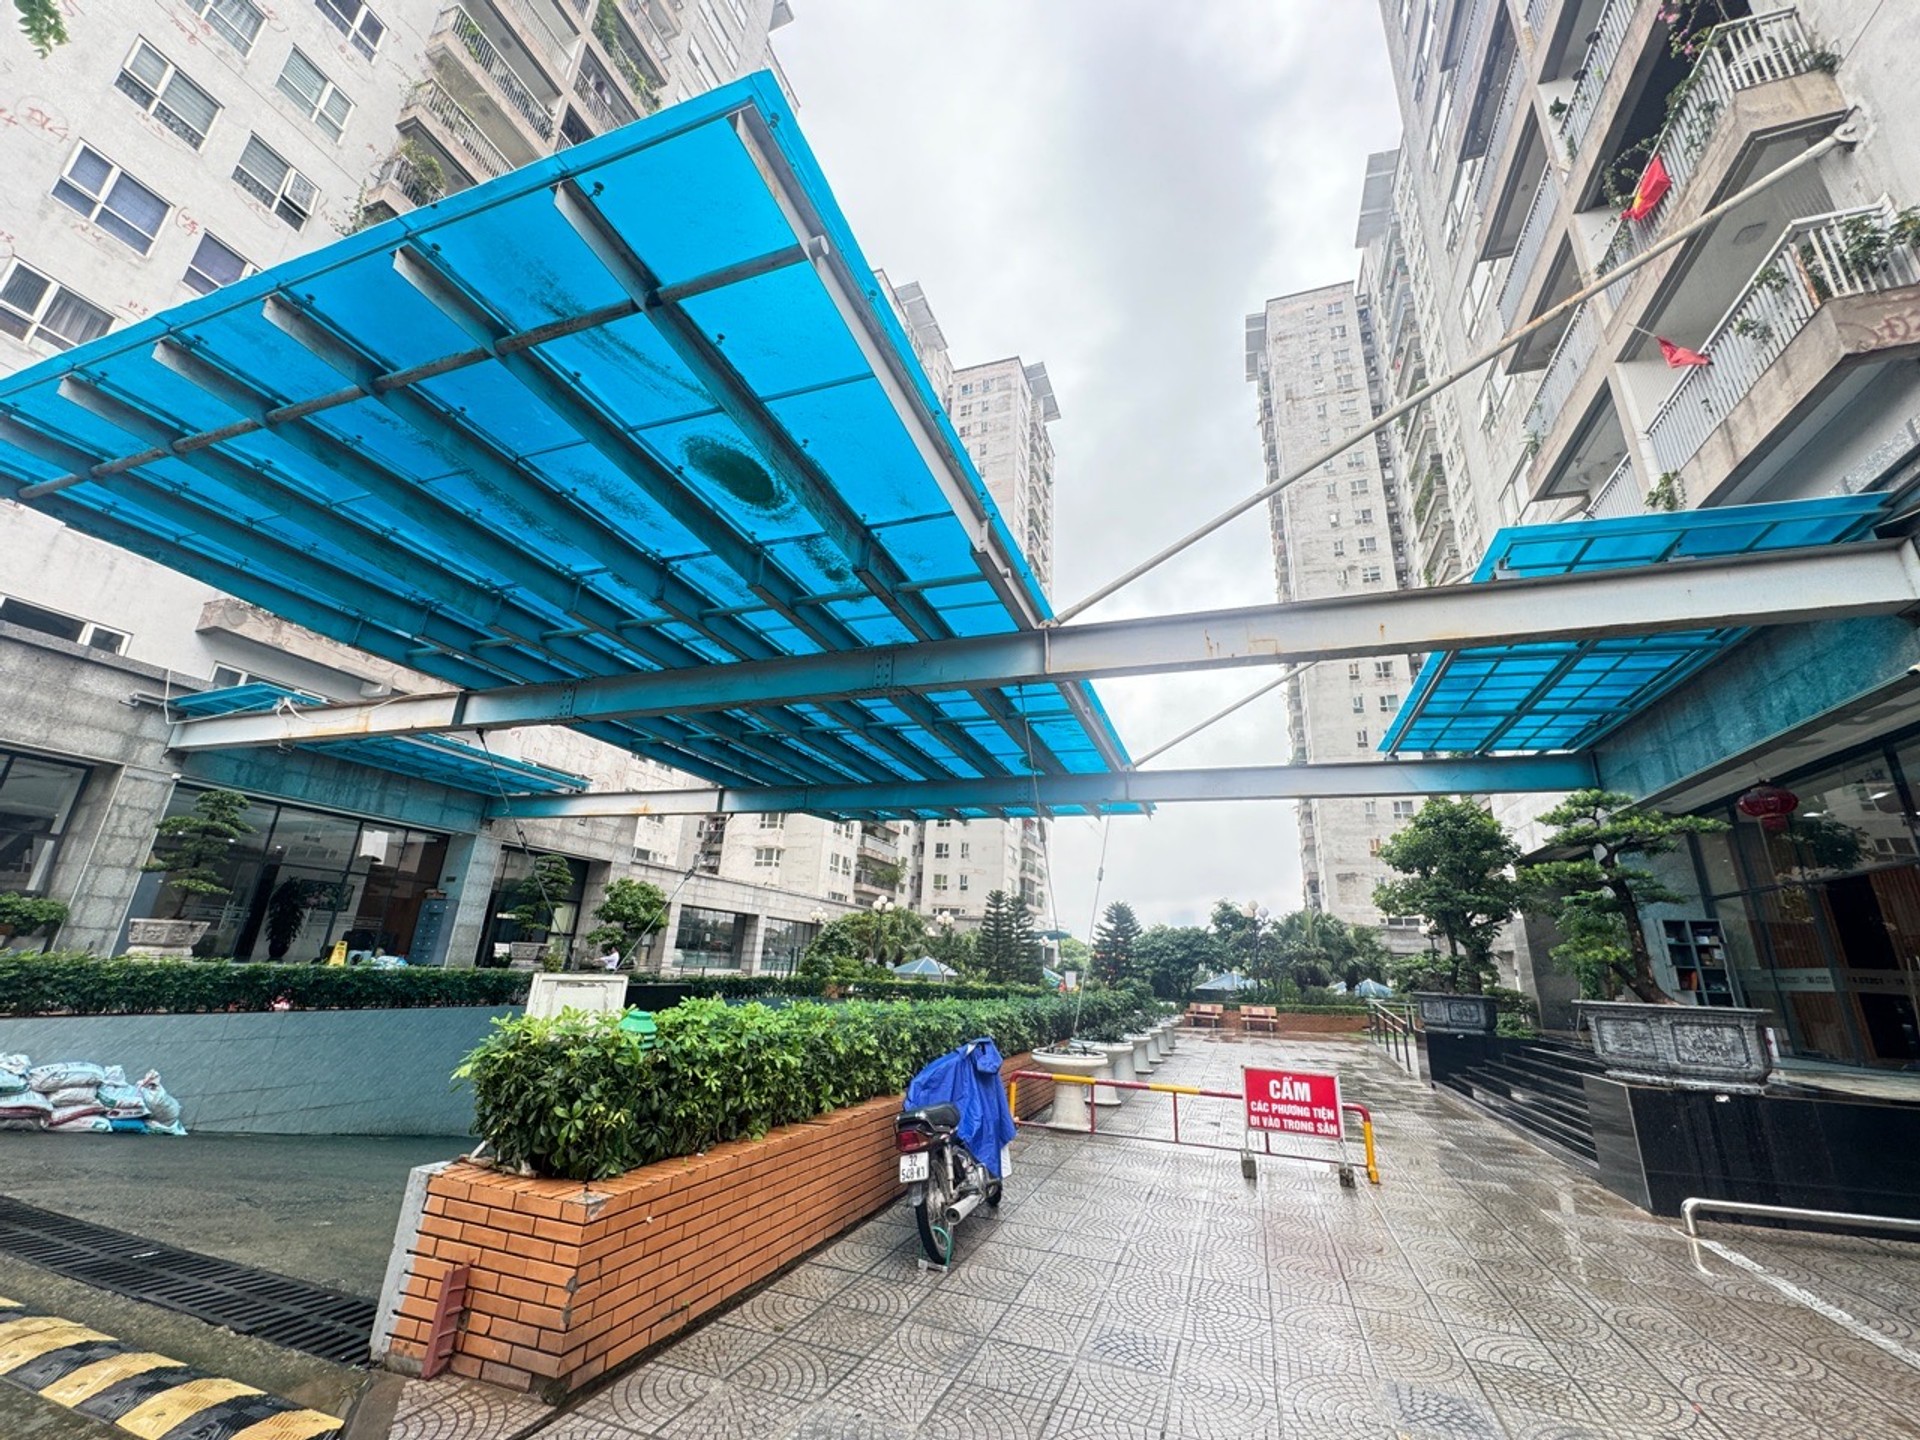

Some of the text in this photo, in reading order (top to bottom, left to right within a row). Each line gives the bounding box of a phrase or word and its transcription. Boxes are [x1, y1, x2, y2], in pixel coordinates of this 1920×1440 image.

[1269, 1076, 1311, 1102] CẤM
[1250, 1100, 1335, 1121] CÁC PHƯƠNG TIỆN
[1250, 1115, 1260, 1127] ĐI
[1262, 1114, 1281, 1129] VÀO
[1283, 1118, 1315, 1132] TRONG
